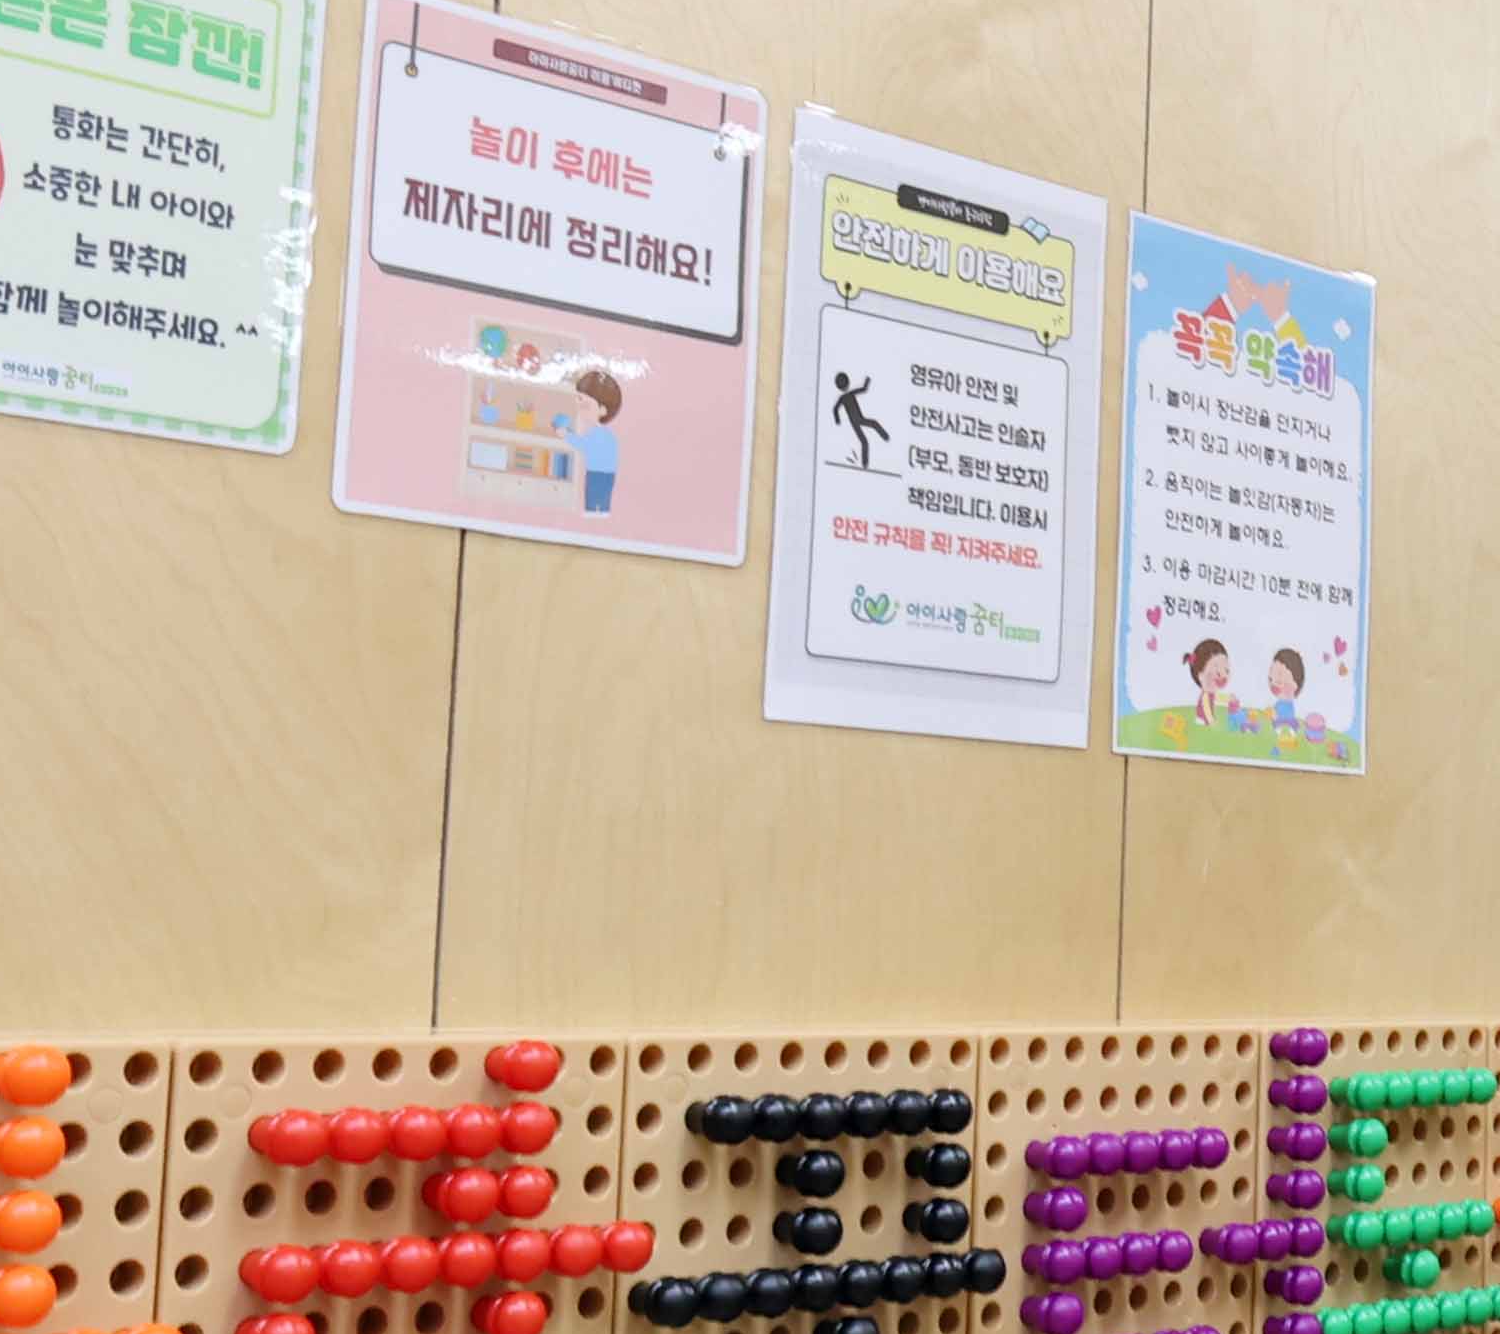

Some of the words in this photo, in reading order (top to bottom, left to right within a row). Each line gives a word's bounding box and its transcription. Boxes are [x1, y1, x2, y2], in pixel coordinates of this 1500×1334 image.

[51, 104, 130, 155] 통화는
[139, 122, 226, 173] 간단히,
[469, 115, 540, 169] 놀이
[553, 138, 653, 200] 후에는
[22, 162, 103, 209] 소중한
[110, 177, 141, 211] 내
[150, 189, 235, 230] 아이와
[73, 232, 99, 268] 눈
[108, 237, 188, 280] 맞추며
[403, 176, 552, 250] 제자리에
[565, 215, 714, 286] 정리해요!
[831, 210, 951, 278] 안전하게
[956, 244, 1066, 307] 이용해요
[56, 289, 227, 349] 놀이해주세요.
[1173, 311, 1237, 372] 꼭꼭
[1245, 331, 1333, 394] 약속해
[910, 362, 961, 395] 영유아
[966, 374, 1000, 404] 안전
[1002, 382, 1020, 408] 및
[910, 403, 994, 444] 안전사고는
[997, 421, 1047, 453] 인솔자
[1147, 382, 1162, 405] 1.
[1166, 386, 1211, 412] 놀이시
[1216, 398, 1271, 430] 장난감을
[1276, 412, 1333, 444] 던지거나
[958, 452, 991, 481] 동반
[994, 461, 1050, 493] 보호자)
[1201, 431, 1230, 457] 않고
[1235, 441, 1290, 470] 사이좋게
[907, 485, 996, 523] 책임입니다.
[999, 501, 1048, 532] 이용시
[1144, 470, 1159, 489] 2.
[1164, 472, 1223, 503] 움직이는
[832, 514, 869, 543] 안전
[930, 531, 954, 556] 꼭!
[956, 535, 1043, 571] 지켜주세요.
[1164, 508, 1223, 539] 안전하게
[1228, 521, 1290, 551] 놀이해요.
[1142, 554, 1157, 575] 3.
[1162, 556, 1191, 581] 이용
[1197, 562, 1258, 593] 마감시간
[1260, 573, 1293, 598] 10분
[1296, 579, 1324, 603] 전에
[1328, 584, 1355, 608] 함께
[1161, 593, 1227, 625] 정리해요.
